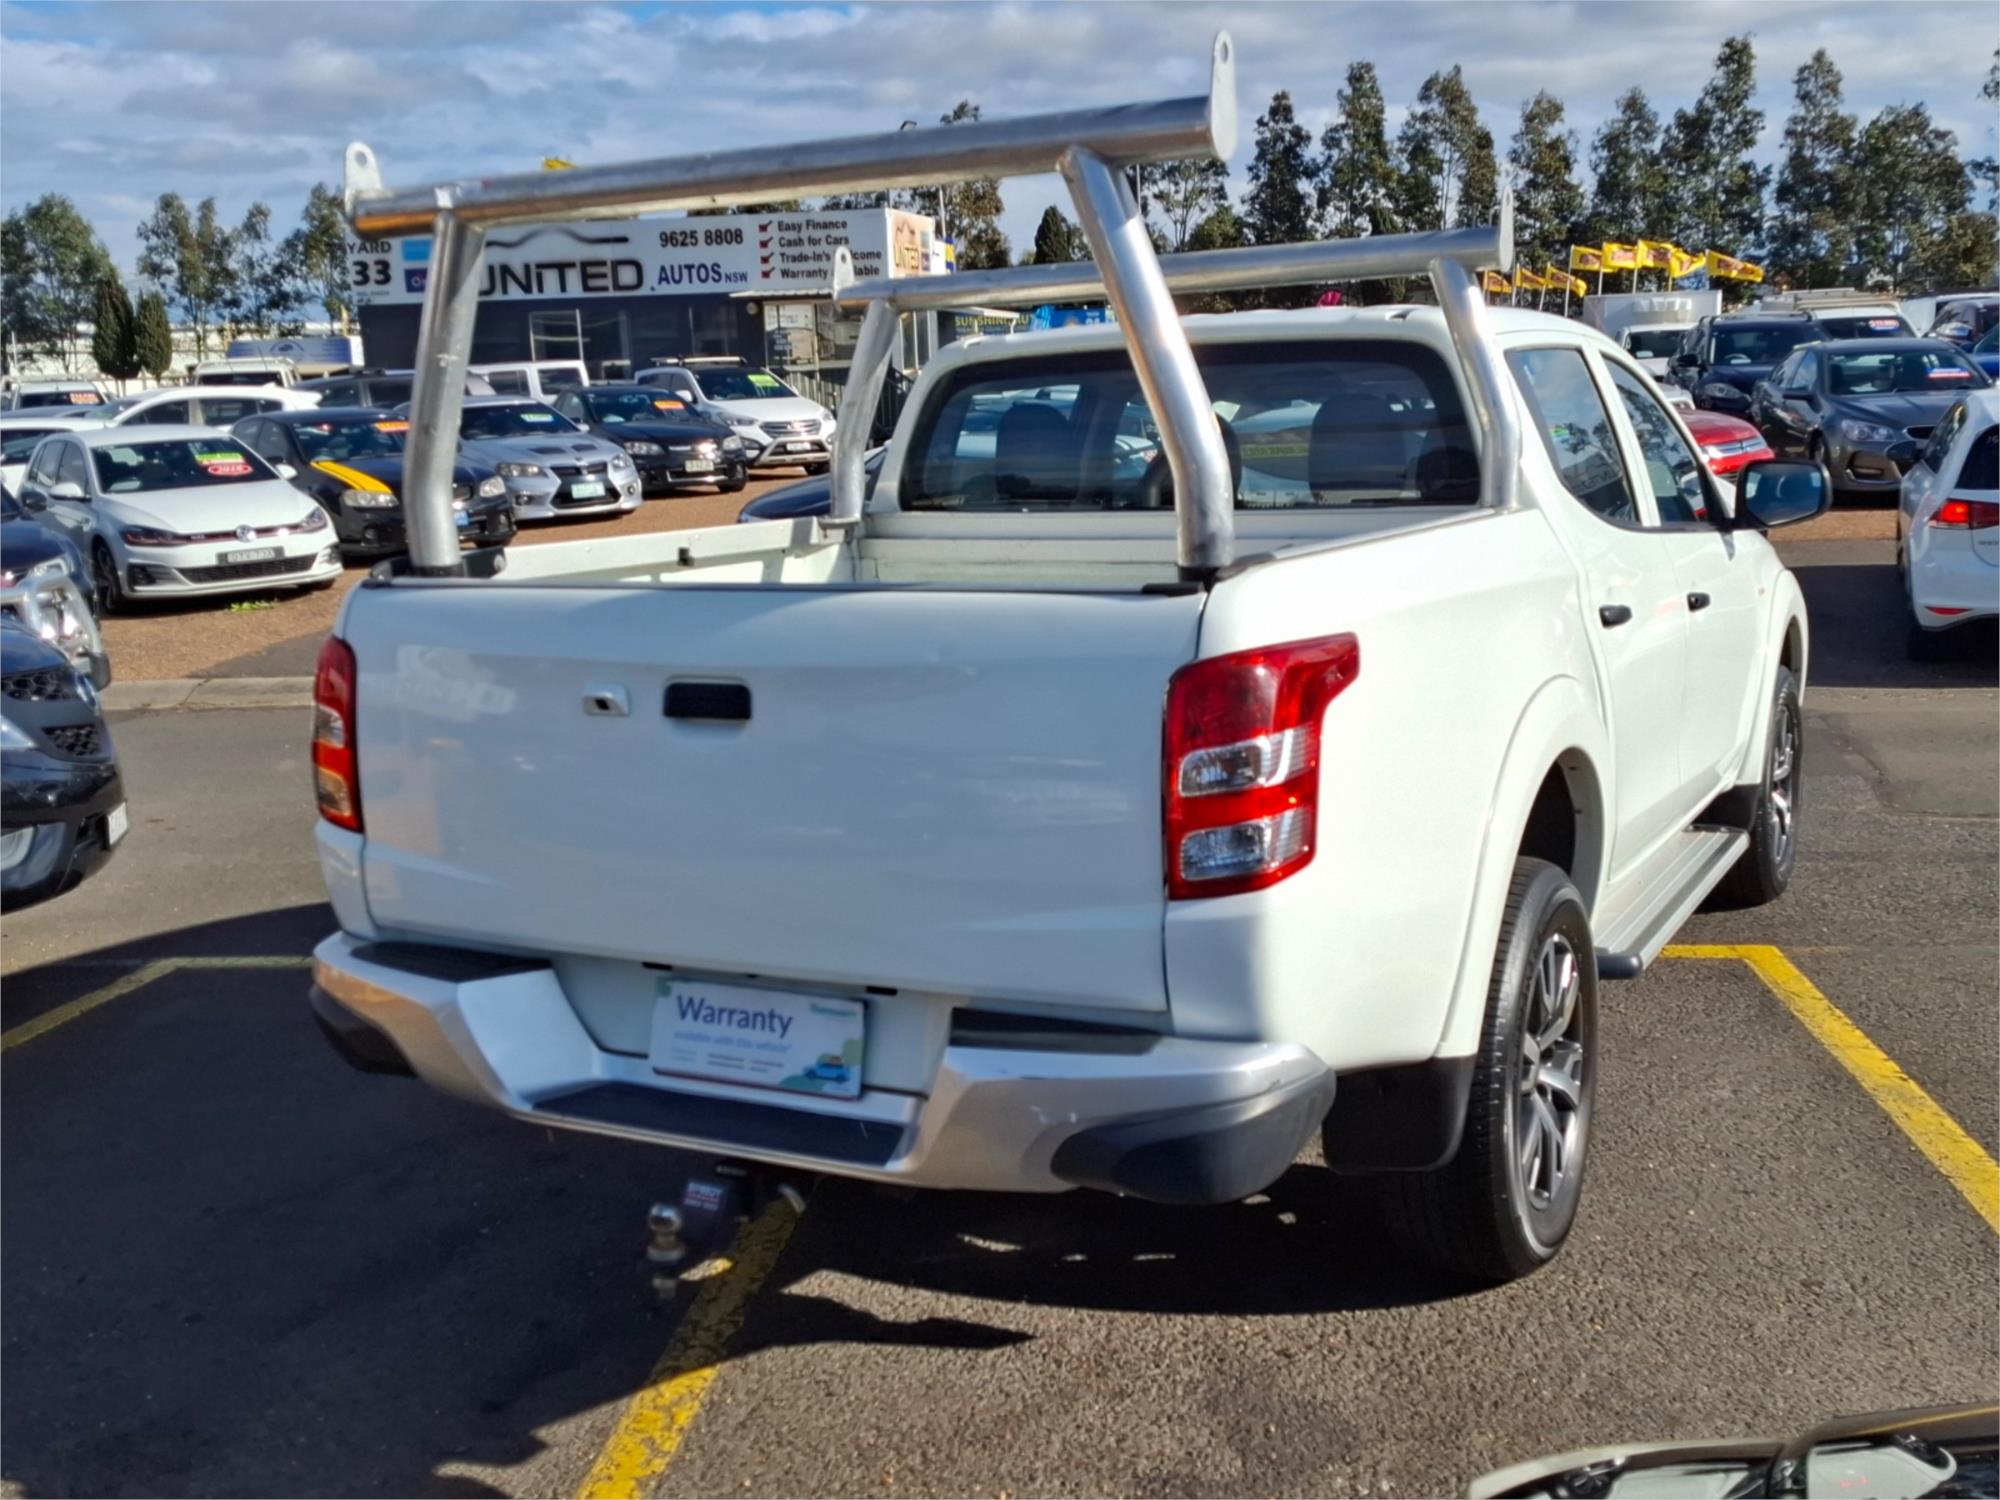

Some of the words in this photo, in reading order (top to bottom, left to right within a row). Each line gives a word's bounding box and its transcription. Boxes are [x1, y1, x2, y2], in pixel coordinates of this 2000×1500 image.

[778, 221, 802, 232] Easy
[806, 219, 847, 231] Finance
[659, 231, 698, 248] 9625
[704, 228, 744, 246] 8808
[779, 236, 804, 248] Cash
[808, 236, 824, 247] for
[826, 235, 849, 246] Cars
[347, 241, 391, 254] YARD
[353, 260, 392, 286] 33
[724, 271, 748, 284] NSW
[781, 268, 828, 281] Warranty
[677, 996, 793, 1039] Warranty
